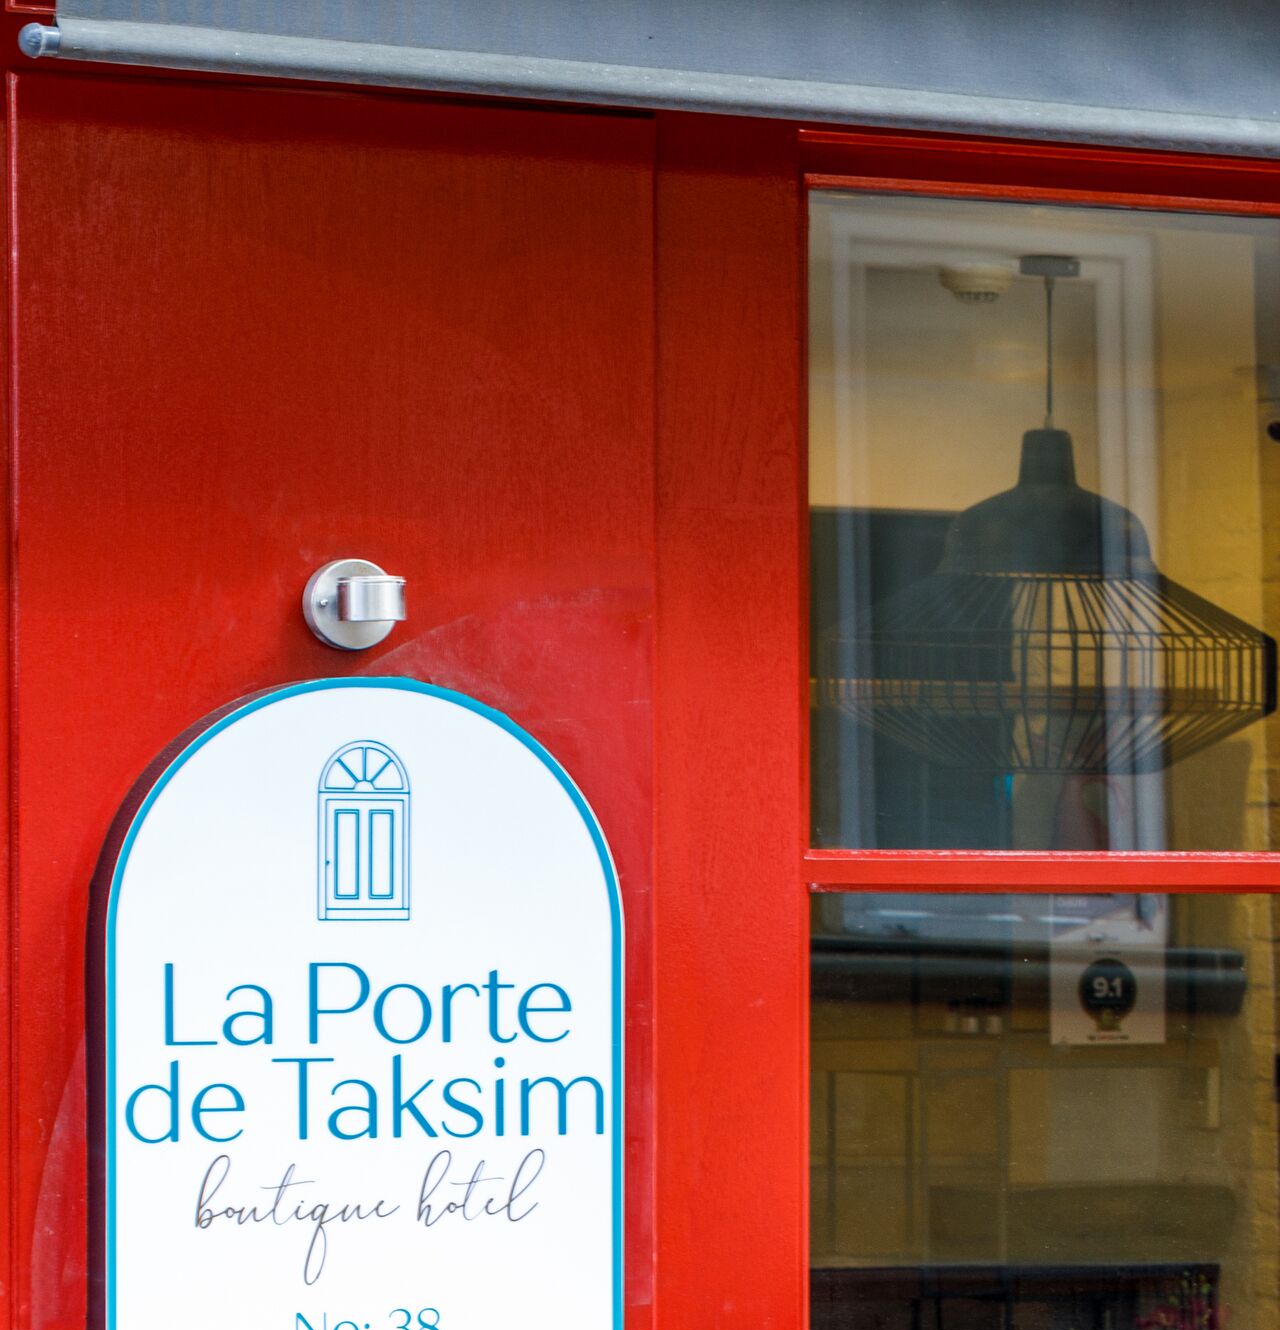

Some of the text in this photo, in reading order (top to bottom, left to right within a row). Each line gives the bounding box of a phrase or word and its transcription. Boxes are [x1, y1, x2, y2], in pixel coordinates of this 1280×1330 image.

[164, 961, 573, 1047] La Porte
[1092, 976, 1123, 998] 9.1
[124, 1053, 605, 1145] de Taksim
[195, 1148, 546, 1286] boutique hotel
